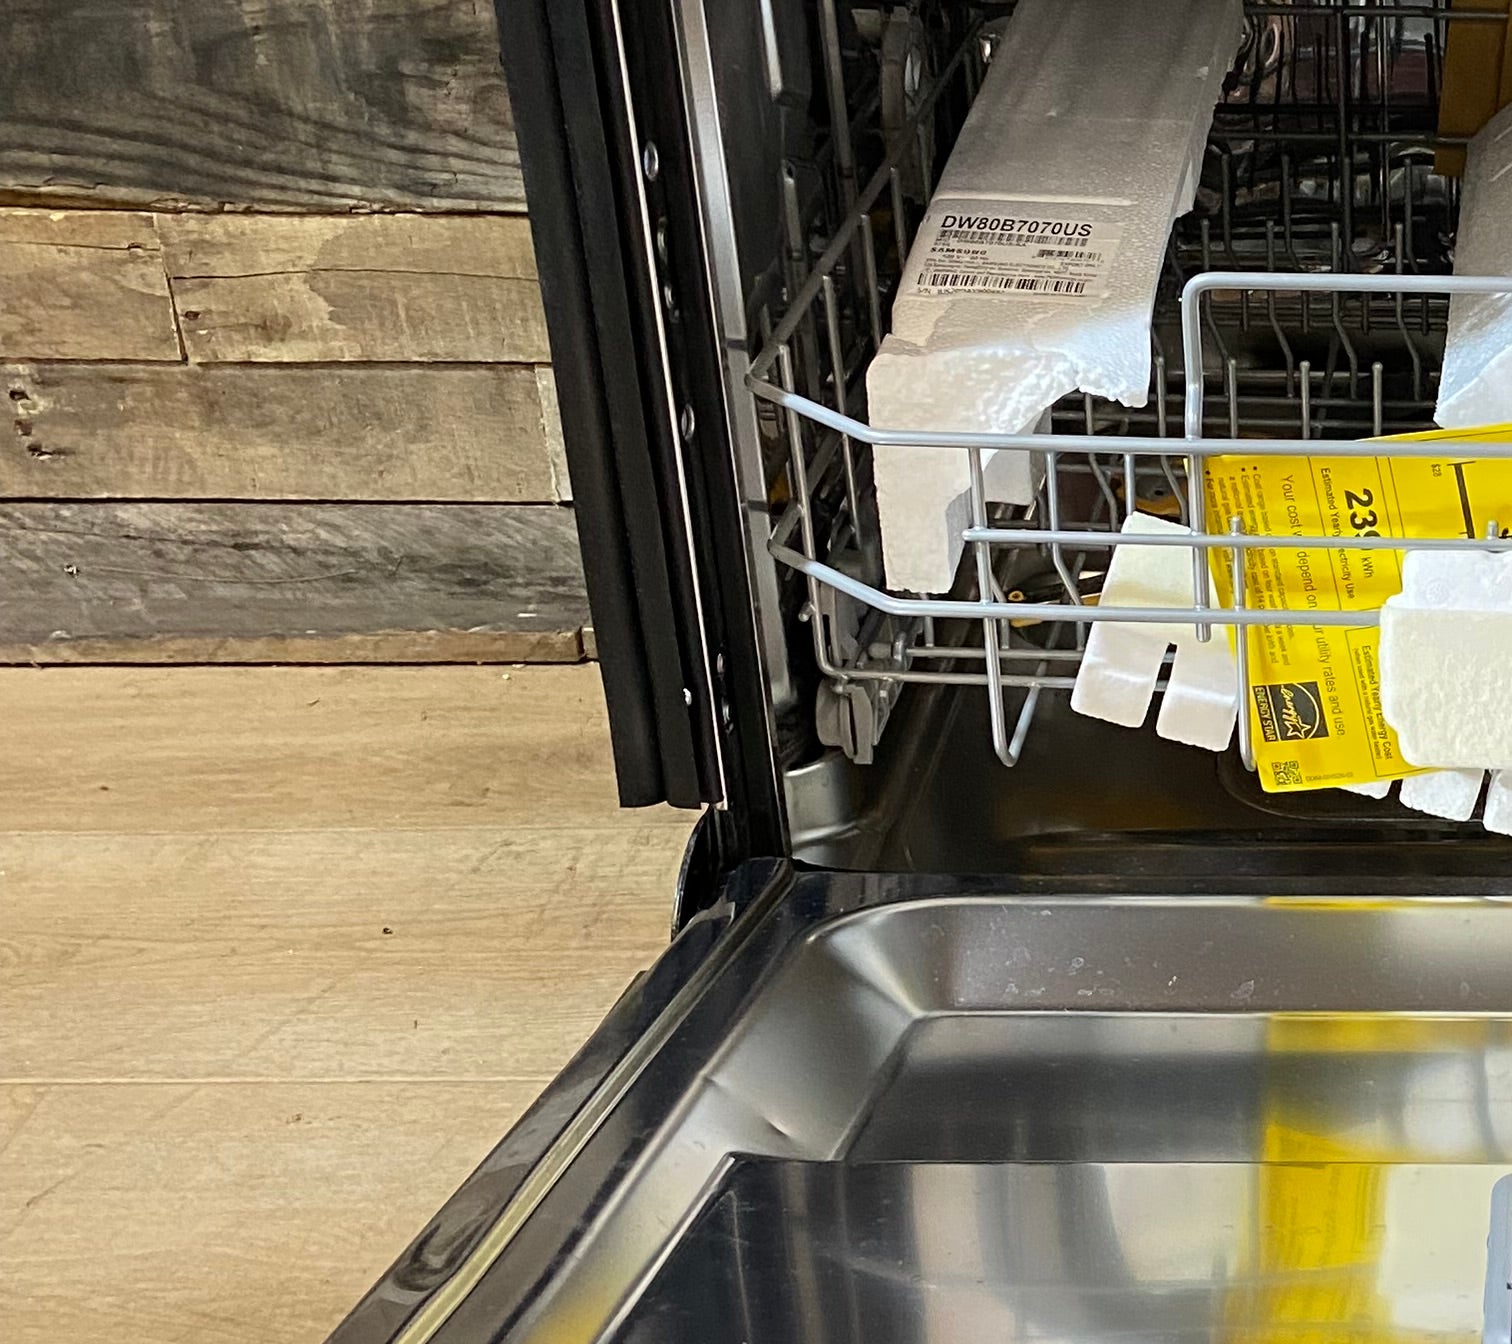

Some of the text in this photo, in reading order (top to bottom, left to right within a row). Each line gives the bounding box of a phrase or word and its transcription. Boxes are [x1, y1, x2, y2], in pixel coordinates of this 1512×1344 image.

[940, 215, 1093, 237] DW80B7070US
[1282, 474, 1296, 502] Your
[1287, 504, 1300, 525] cost
[1321, 467, 1338, 510] Estimated
[1344, 583, 1355, 599] Use
[1296, 551, 1318, 592] depend
[1361, 557, 1374, 578] kWh
[1306, 594, 1318, 608] on
[1316, 637, 1330, 664] utility
[1323, 666, 1338, 693] rates
[1254, 687, 1277, 741] ENERGY STAR
[1329, 696, 1342, 714] and
[1361, 644, 1394, 760] Estimated Yearly Energy Cost
